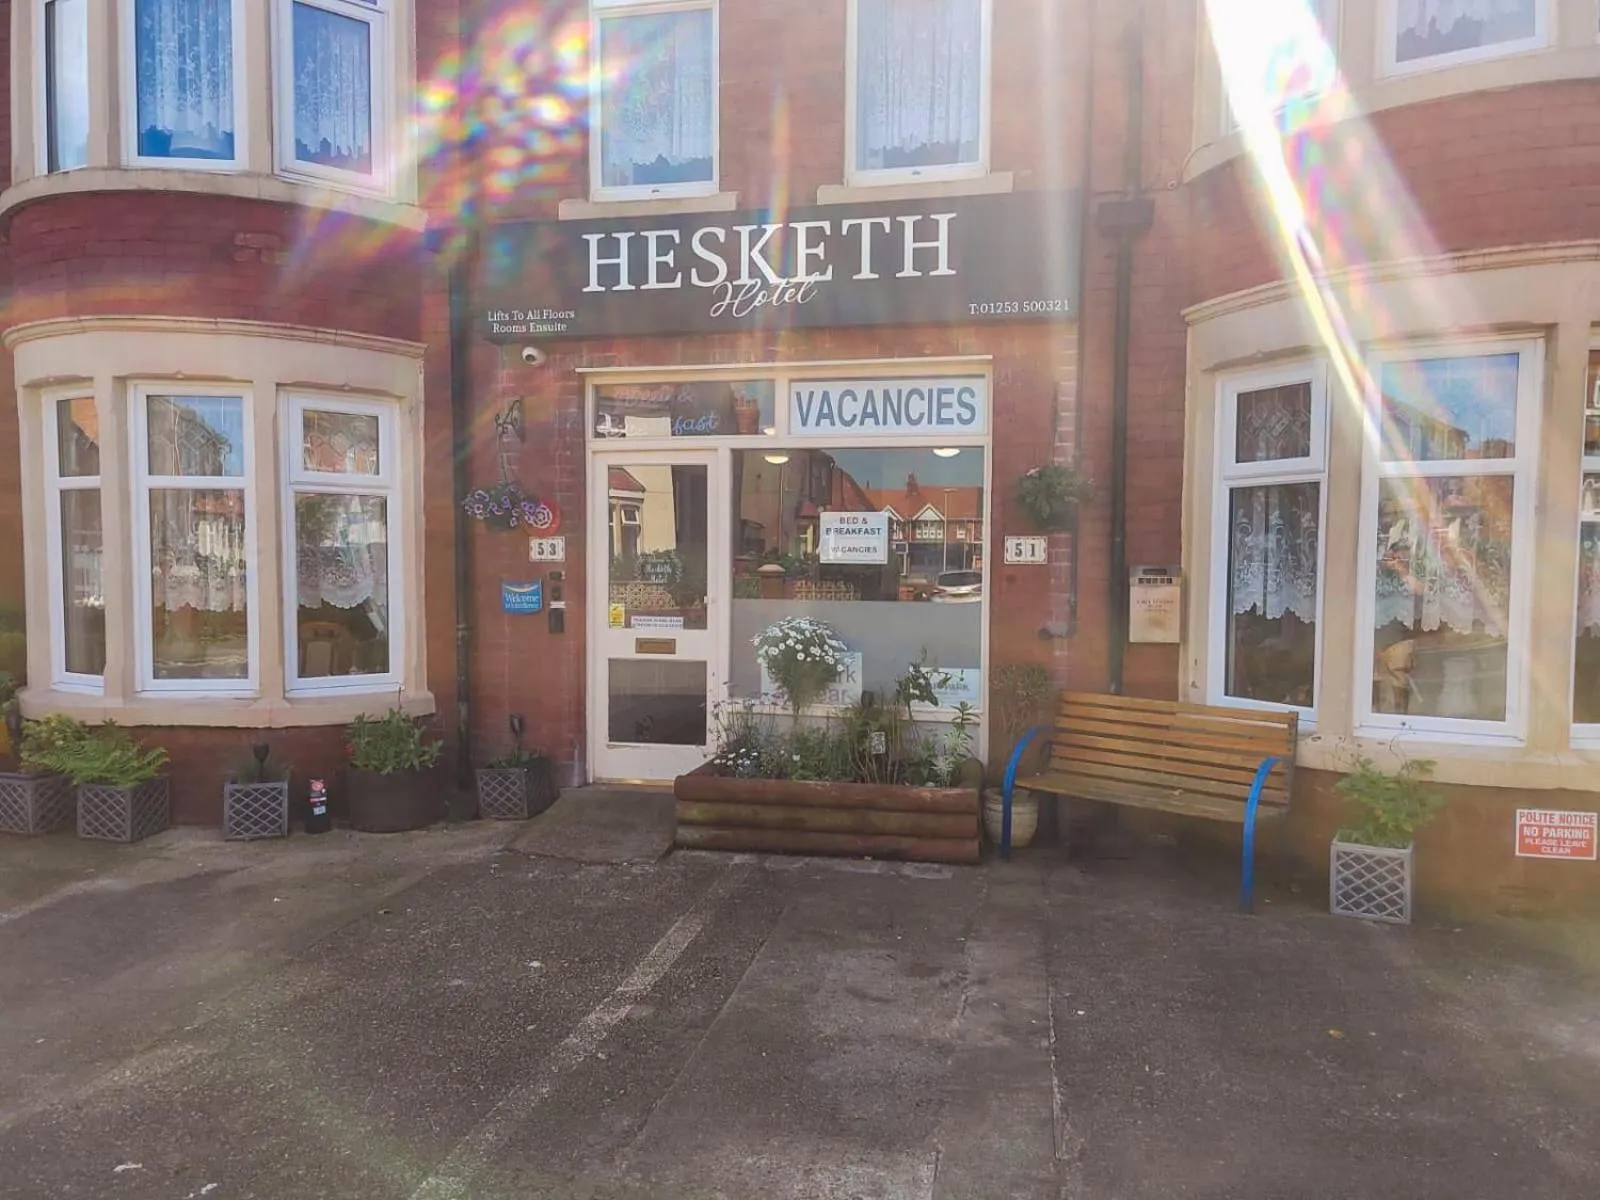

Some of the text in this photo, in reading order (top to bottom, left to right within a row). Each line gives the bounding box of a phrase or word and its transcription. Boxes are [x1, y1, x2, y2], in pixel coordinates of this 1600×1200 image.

[582, 213, 957, 292] HESKETH
[709, 272, 820, 317] Hotel
[1023, 299, 1070, 312] 500321
[487, 308, 575, 321] Lifts To All Floors
[493, 321, 568, 333] Rooms Ensuite
[795, 387, 976, 427] VACANCIES
[839, 516, 869, 525] BED &
[825, 527, 882, 536] BREAKFAST
[537, 542, 557, 556] 53
[1014, 542, 1036, 557] 51
[1519, 811, 1596, 826] POLITE NOTICE
[1523, 826, 1590, 839] NO PARKING
